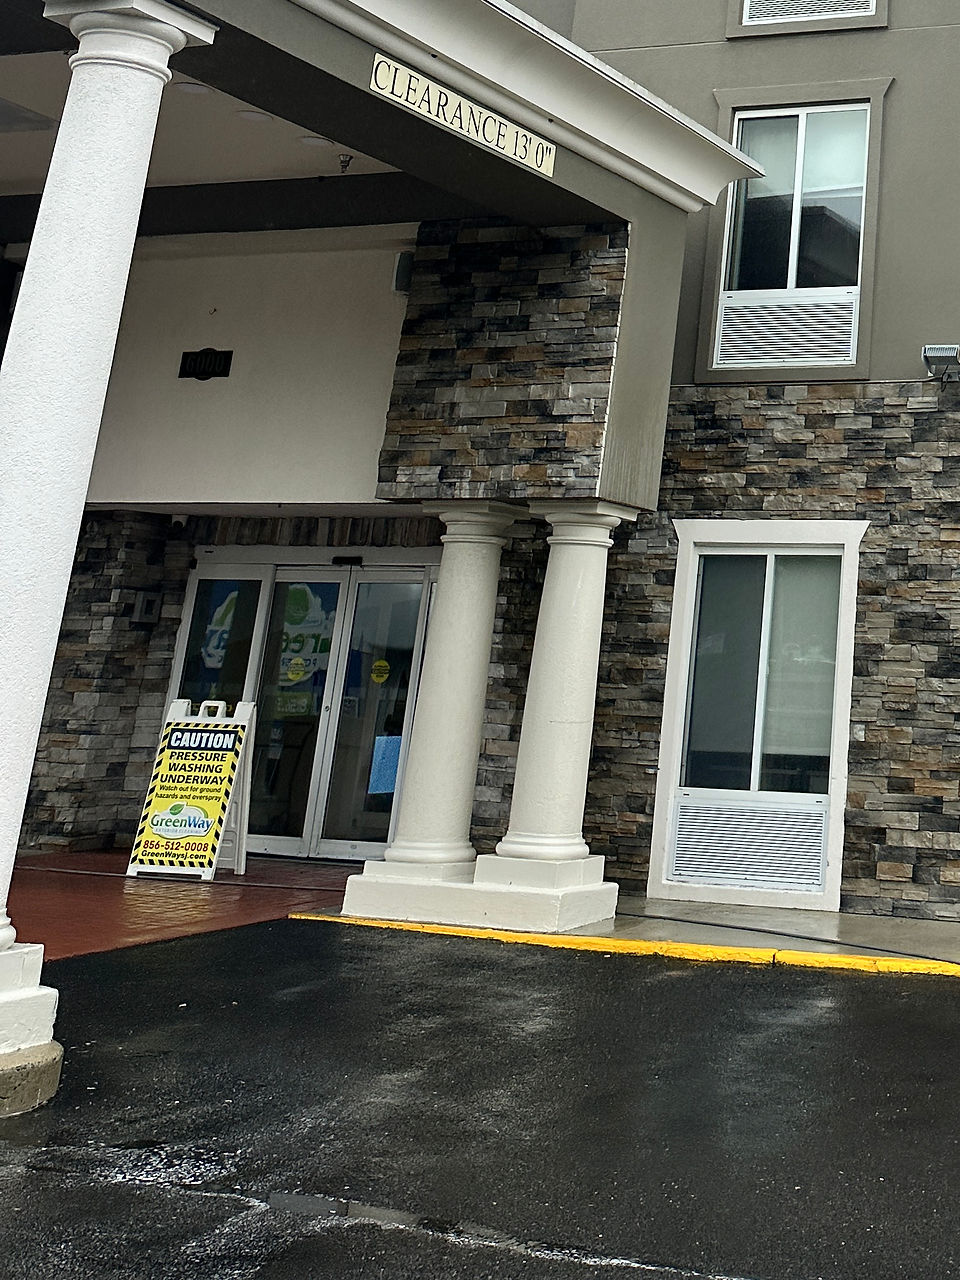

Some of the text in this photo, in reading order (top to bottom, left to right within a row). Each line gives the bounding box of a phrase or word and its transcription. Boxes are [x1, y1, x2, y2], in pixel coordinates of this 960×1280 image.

[373, 60, 508, 151] CLEARANCE
[512, 130, 532, 160] 13'
[170, 731, 235, 749] CAUTION
[169, 751, 228, 762] PRESSURE
[168, 762, 224, 773] WASHING
[160, 773, 227, 785] UNDERWAY
[191, 794, 222, 802] overspray
[150, 814, 214, 832] GreenWay
[142, 840, 209, 852] 856-512-0008
[141, 850, 207, 860] GreenWaysj.com
